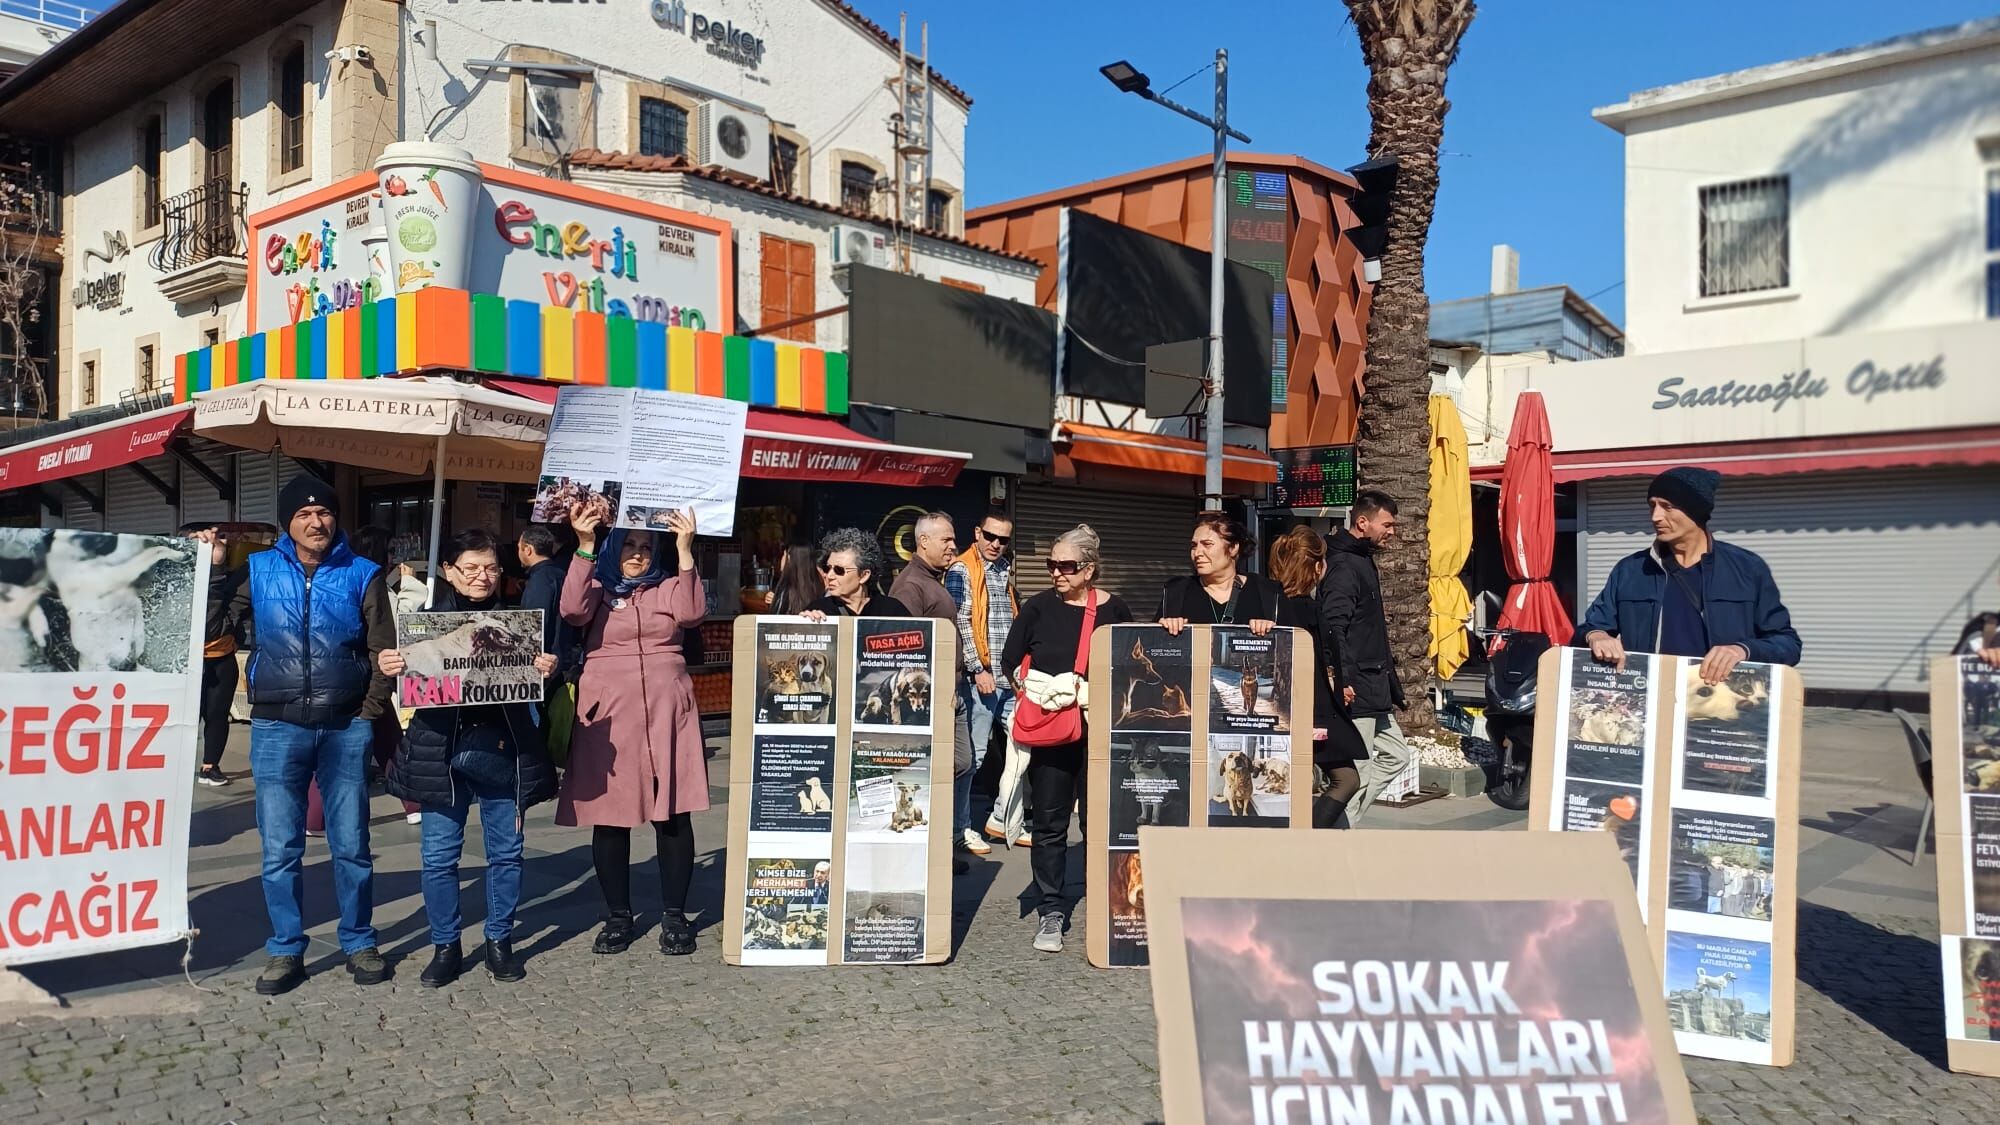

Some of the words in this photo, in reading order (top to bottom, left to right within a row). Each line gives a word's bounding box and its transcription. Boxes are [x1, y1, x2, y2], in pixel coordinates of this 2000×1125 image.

[651, 0, 686, 34] ali
[691, 12, 766, 62] peker
[346, 196, 369, 214] DEVREN
[395, 205, 415, 221] FRESH
[659, 225, 695, 243] DEVREN
[87, 271, 126, 305] peker
[1652, 369, 1828, 413] Saatçıoğlu
[207, 397, 249, 414] GELATERIA
[287, 395, 310, 410] LA
[319, 397, 436, 417] GELATERIA
[473, 408, 494, 422] LA
[503, 412, 546, 428] GELA
[37, 445, 64, 472] ENERJİ
[64, 440, 93, 465] VİTAMİN
[751, 448, 801, 468] ENERJİ
[807, 451, 861, 471] VİTAMİN
[870, 638, 895, 649] YASA
[897, 635, 920, 648] AÇIK
[403, 675, 461, 706] KAN
[462, 682, 541, 704] KOKUYOR
[1574, 743, 1609, 753] KADERLERİ
[1569, 793, 1589, 806] Onlar
[1976, 844, 2000, 855] FETV
[787, 867, 806, 877] BİZE
[757, 879, 804, 887] MERHAMET
[0, 871, 158, 949] CAĞIZ
[1976, 913, 2000, 928] Diyan
[1313, 959, 1521, 1016] SOKAK
[1243, 1019, 1614, 1078] HAYVANLARI
